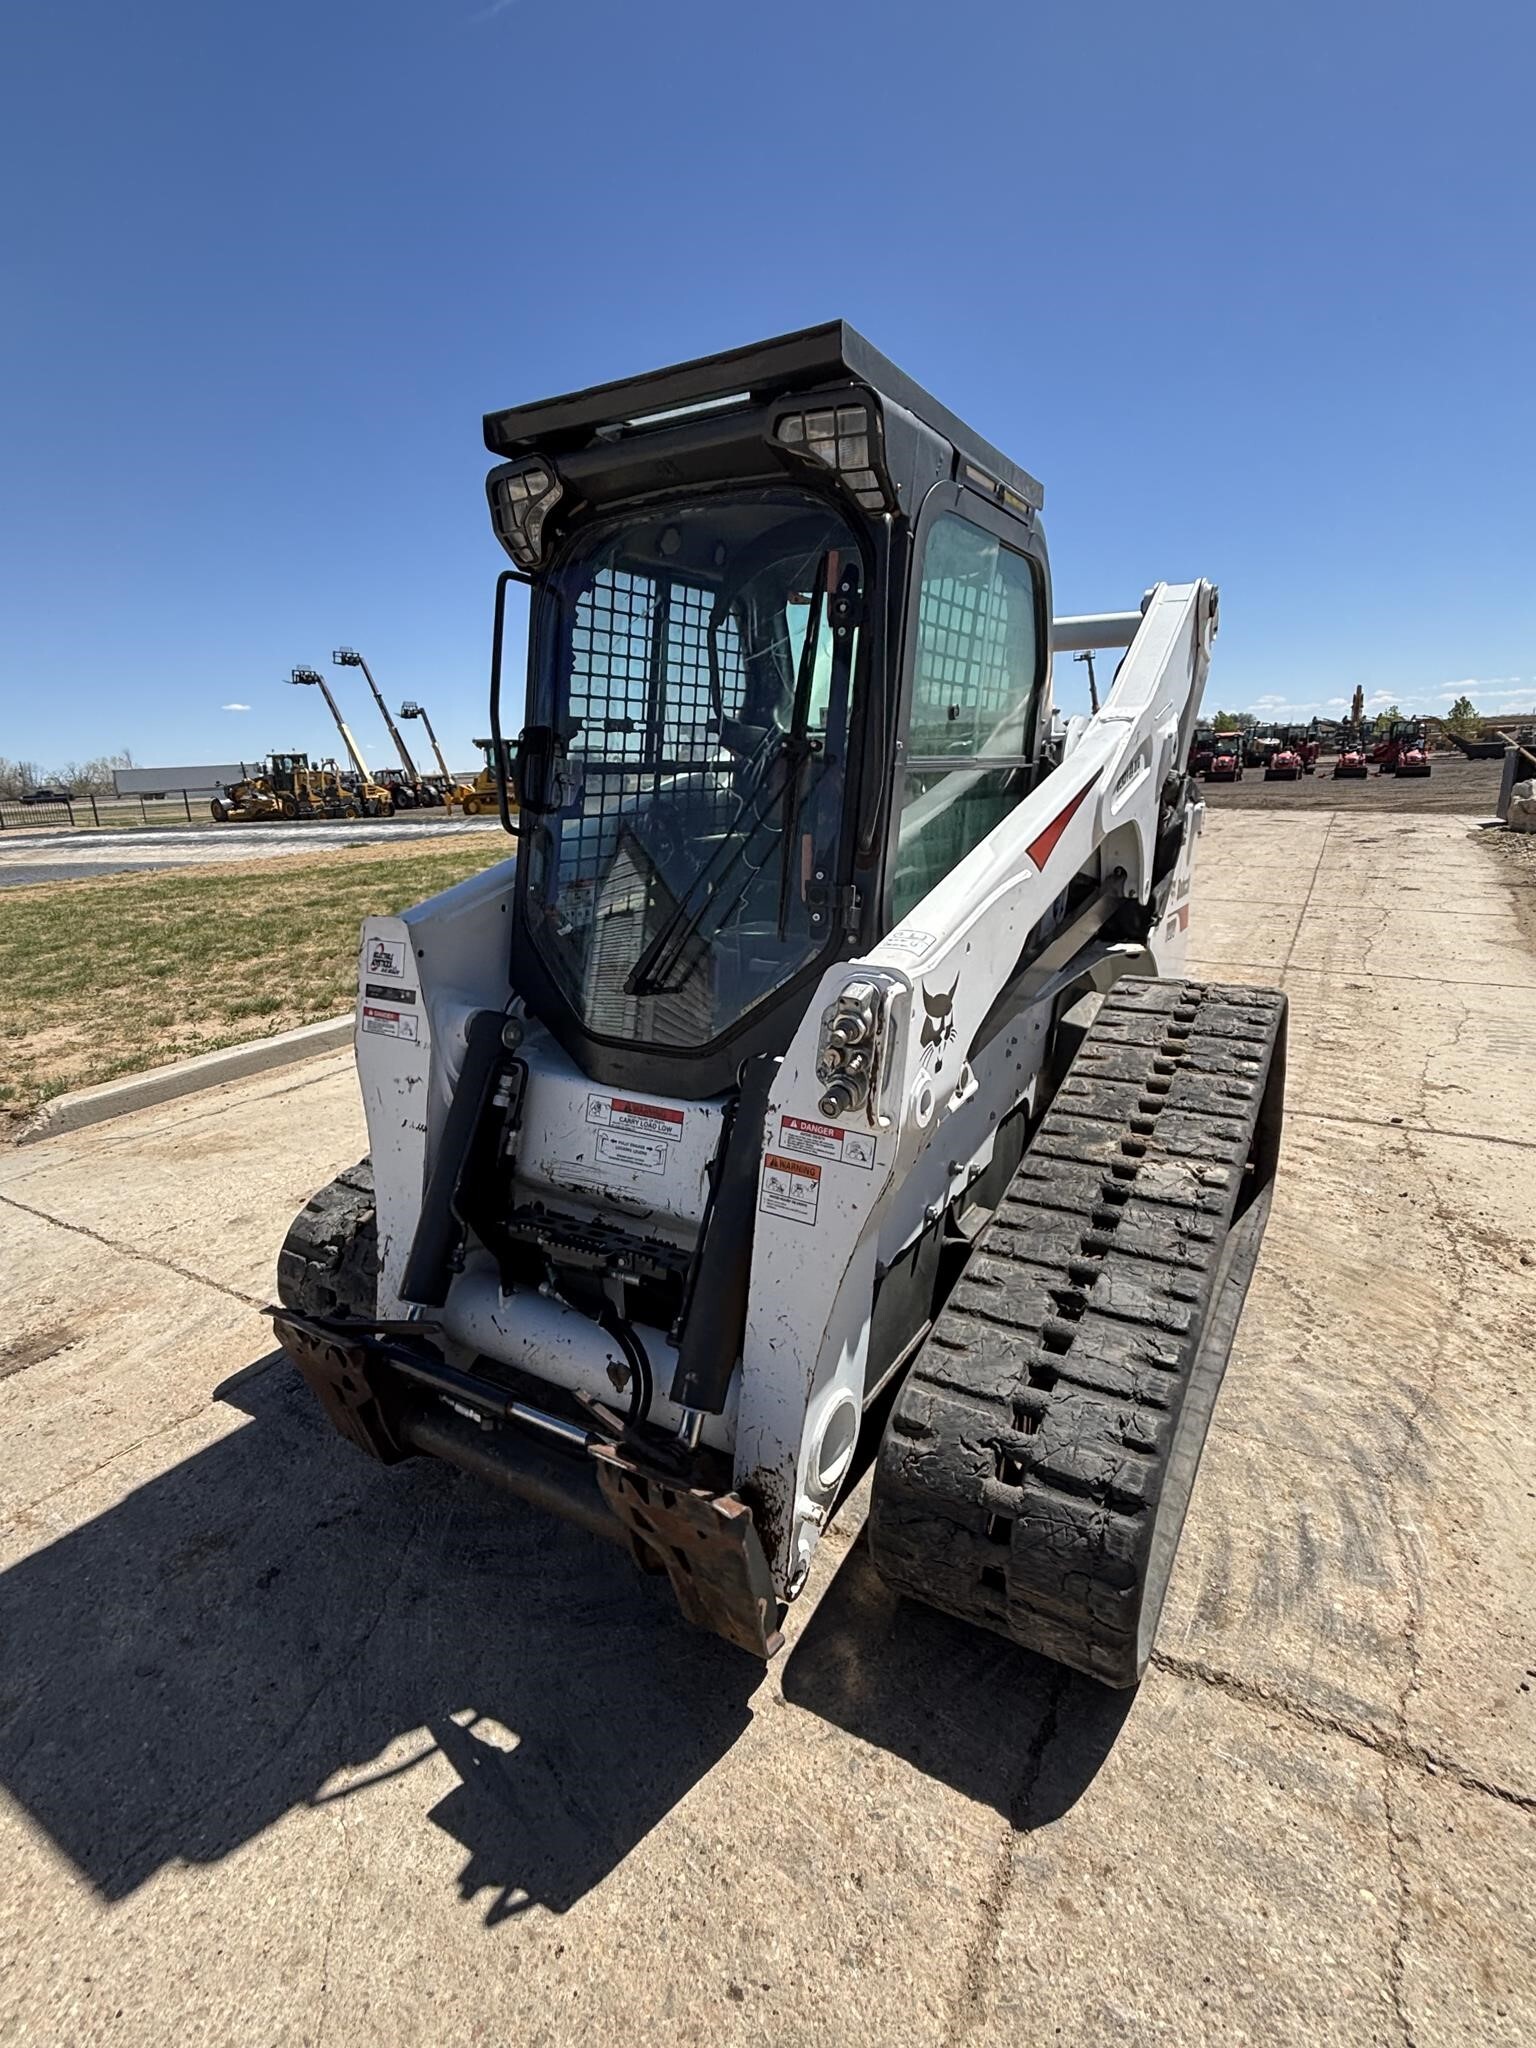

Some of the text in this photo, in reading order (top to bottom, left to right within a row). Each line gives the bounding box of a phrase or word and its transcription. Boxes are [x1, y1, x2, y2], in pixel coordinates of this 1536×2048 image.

[619, 1116, 640, 1126] CARRY
[640, 1120, 657, 1129] LOAD
[658, 1124, 673, 1133] LOW
[800, 1121, 834, 1136] DANGER
[779, 1160, 816, 1177] WARNING
